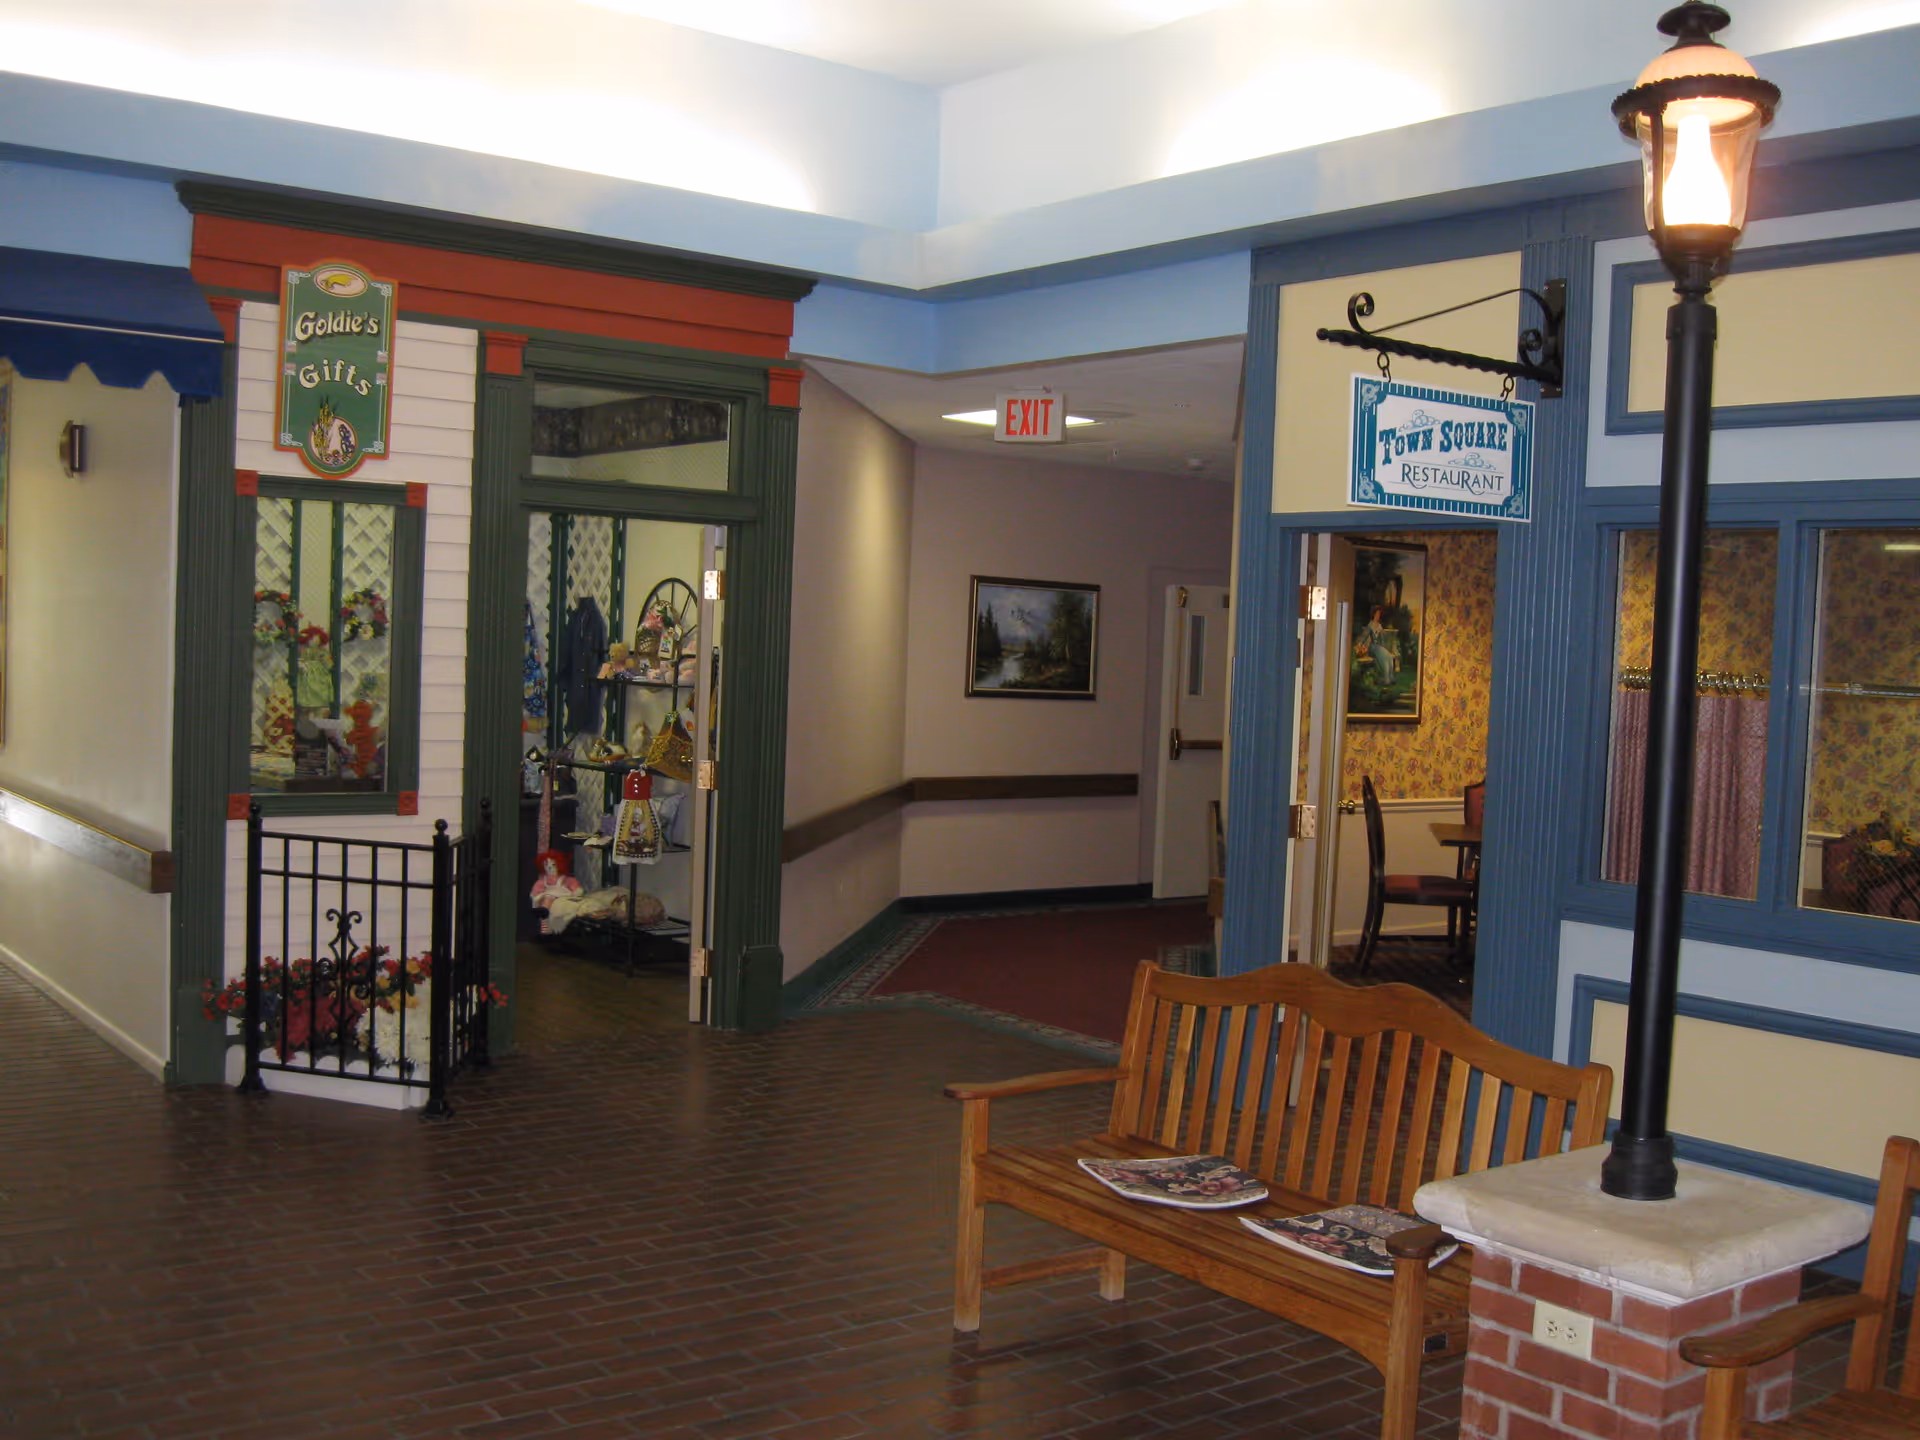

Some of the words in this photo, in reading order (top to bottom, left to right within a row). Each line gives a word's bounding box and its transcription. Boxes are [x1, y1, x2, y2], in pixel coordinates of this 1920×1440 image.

[295, 311, 379, 341] Goldie's
[299, 359, 372, 396] Gifts
[1005, 399, 1054, 435] EXIT
[1379, 427, 1434, 466] TOWN
[1439, 420, 1508, 452] SQUARE
[1401, 463, 1504, 495] RESTAURANT
